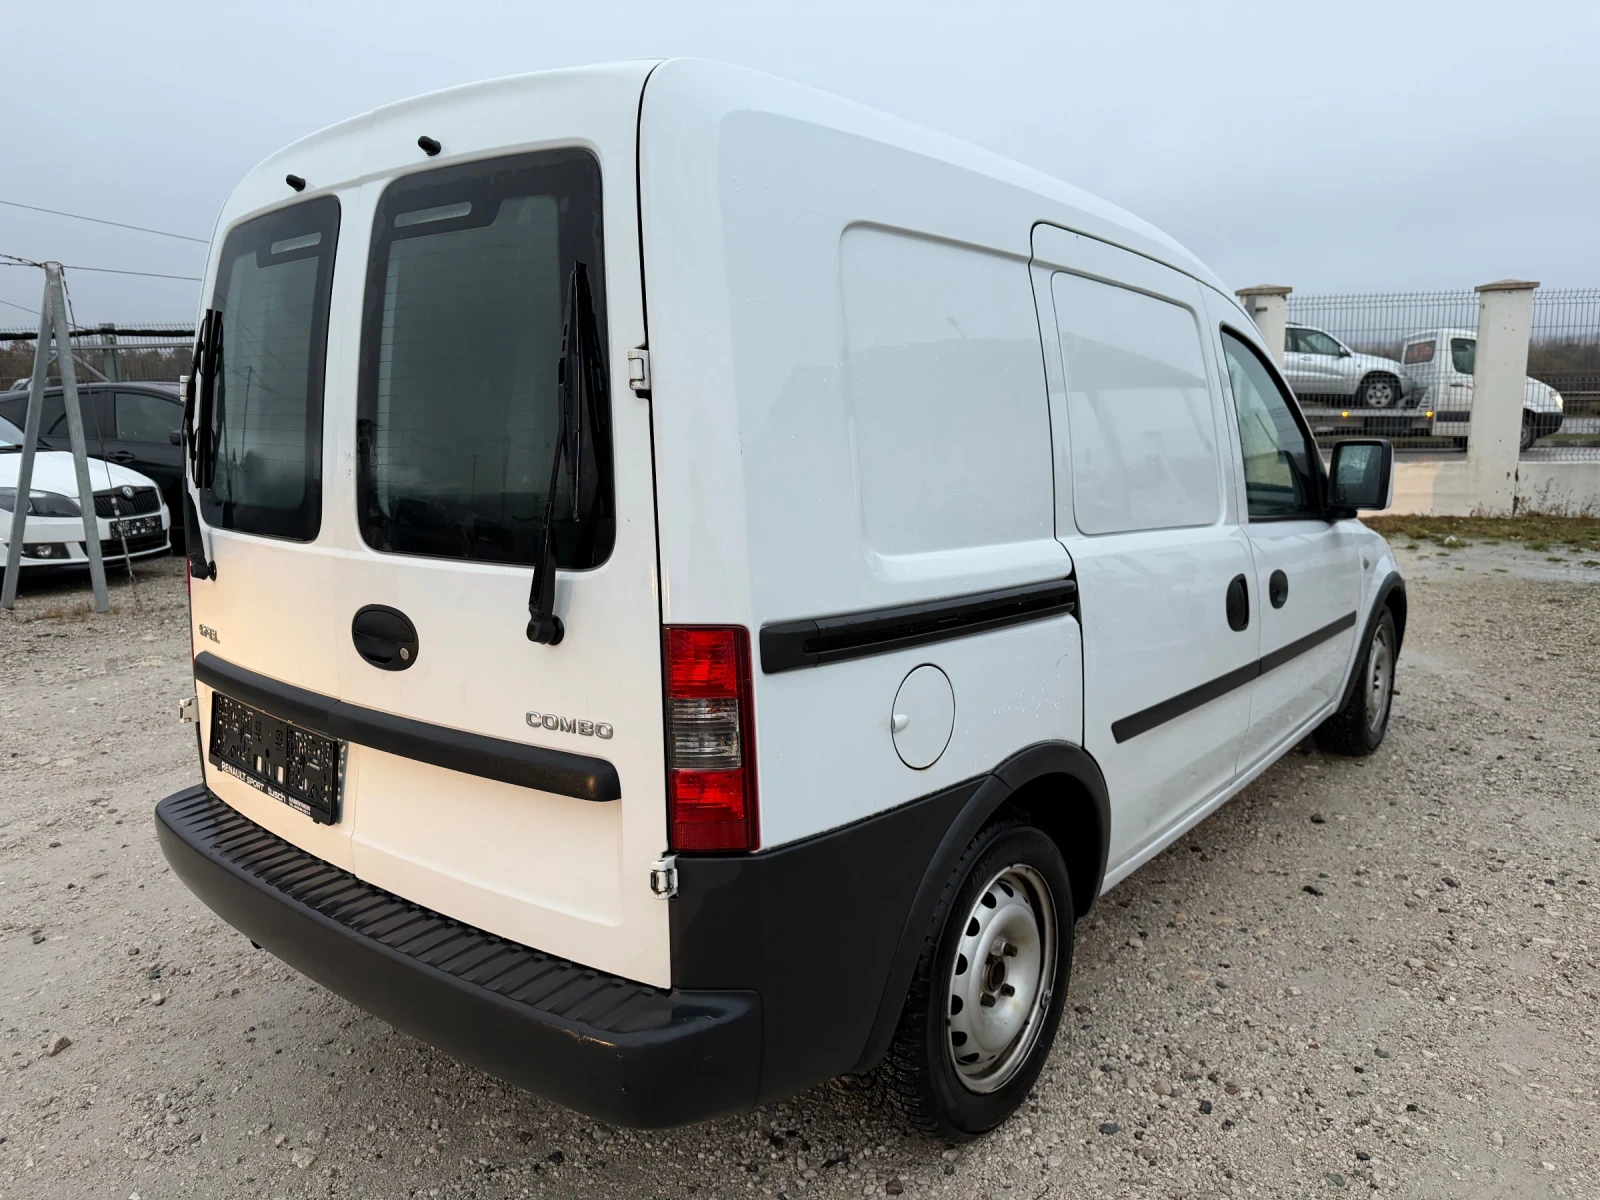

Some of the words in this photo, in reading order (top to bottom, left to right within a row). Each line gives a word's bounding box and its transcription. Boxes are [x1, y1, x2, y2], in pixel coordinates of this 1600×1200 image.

[525, 710, 614, 740] COMBO
[221, 760, 247, 781] RENAULT
[246, 776, 265, 791] SPORT
